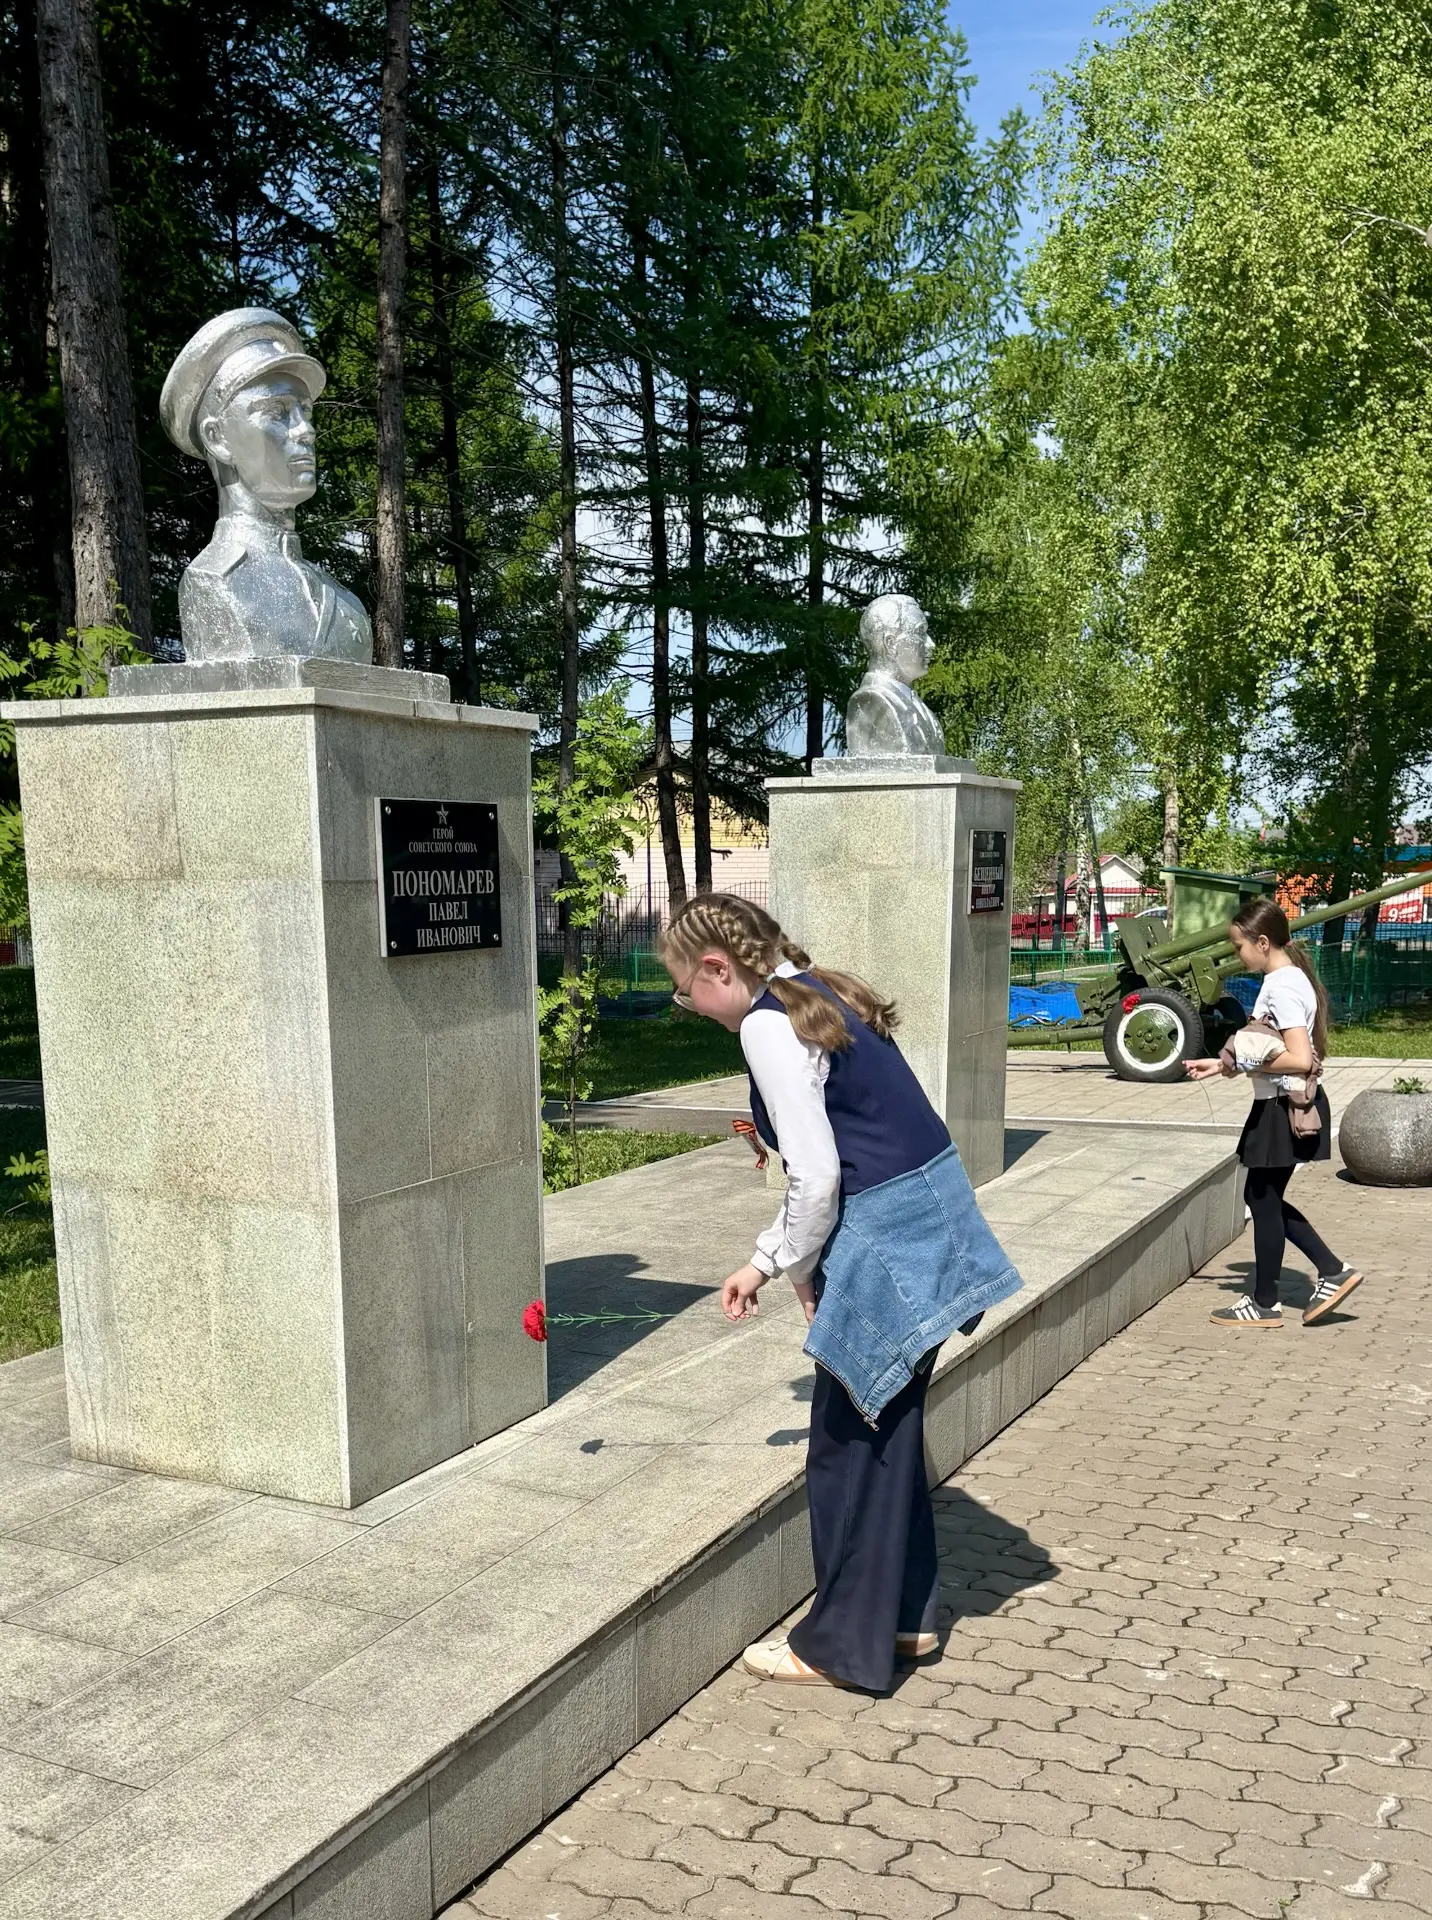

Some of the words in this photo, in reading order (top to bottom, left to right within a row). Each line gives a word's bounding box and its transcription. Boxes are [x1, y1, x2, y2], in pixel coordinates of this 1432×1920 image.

[432, 826, 454, 840] ГЕРОЙ
[408, 841, 453, 853] СОВЕТСКОГО
[454, 841, 478, 854] СОЮЗА
[392, 869, 495, 897] ПОНОМАРЕВ
[429, 901, 468, 921] ПАВЕЛ
[416, 925, 482, 948] ИВАНОВИЧ
